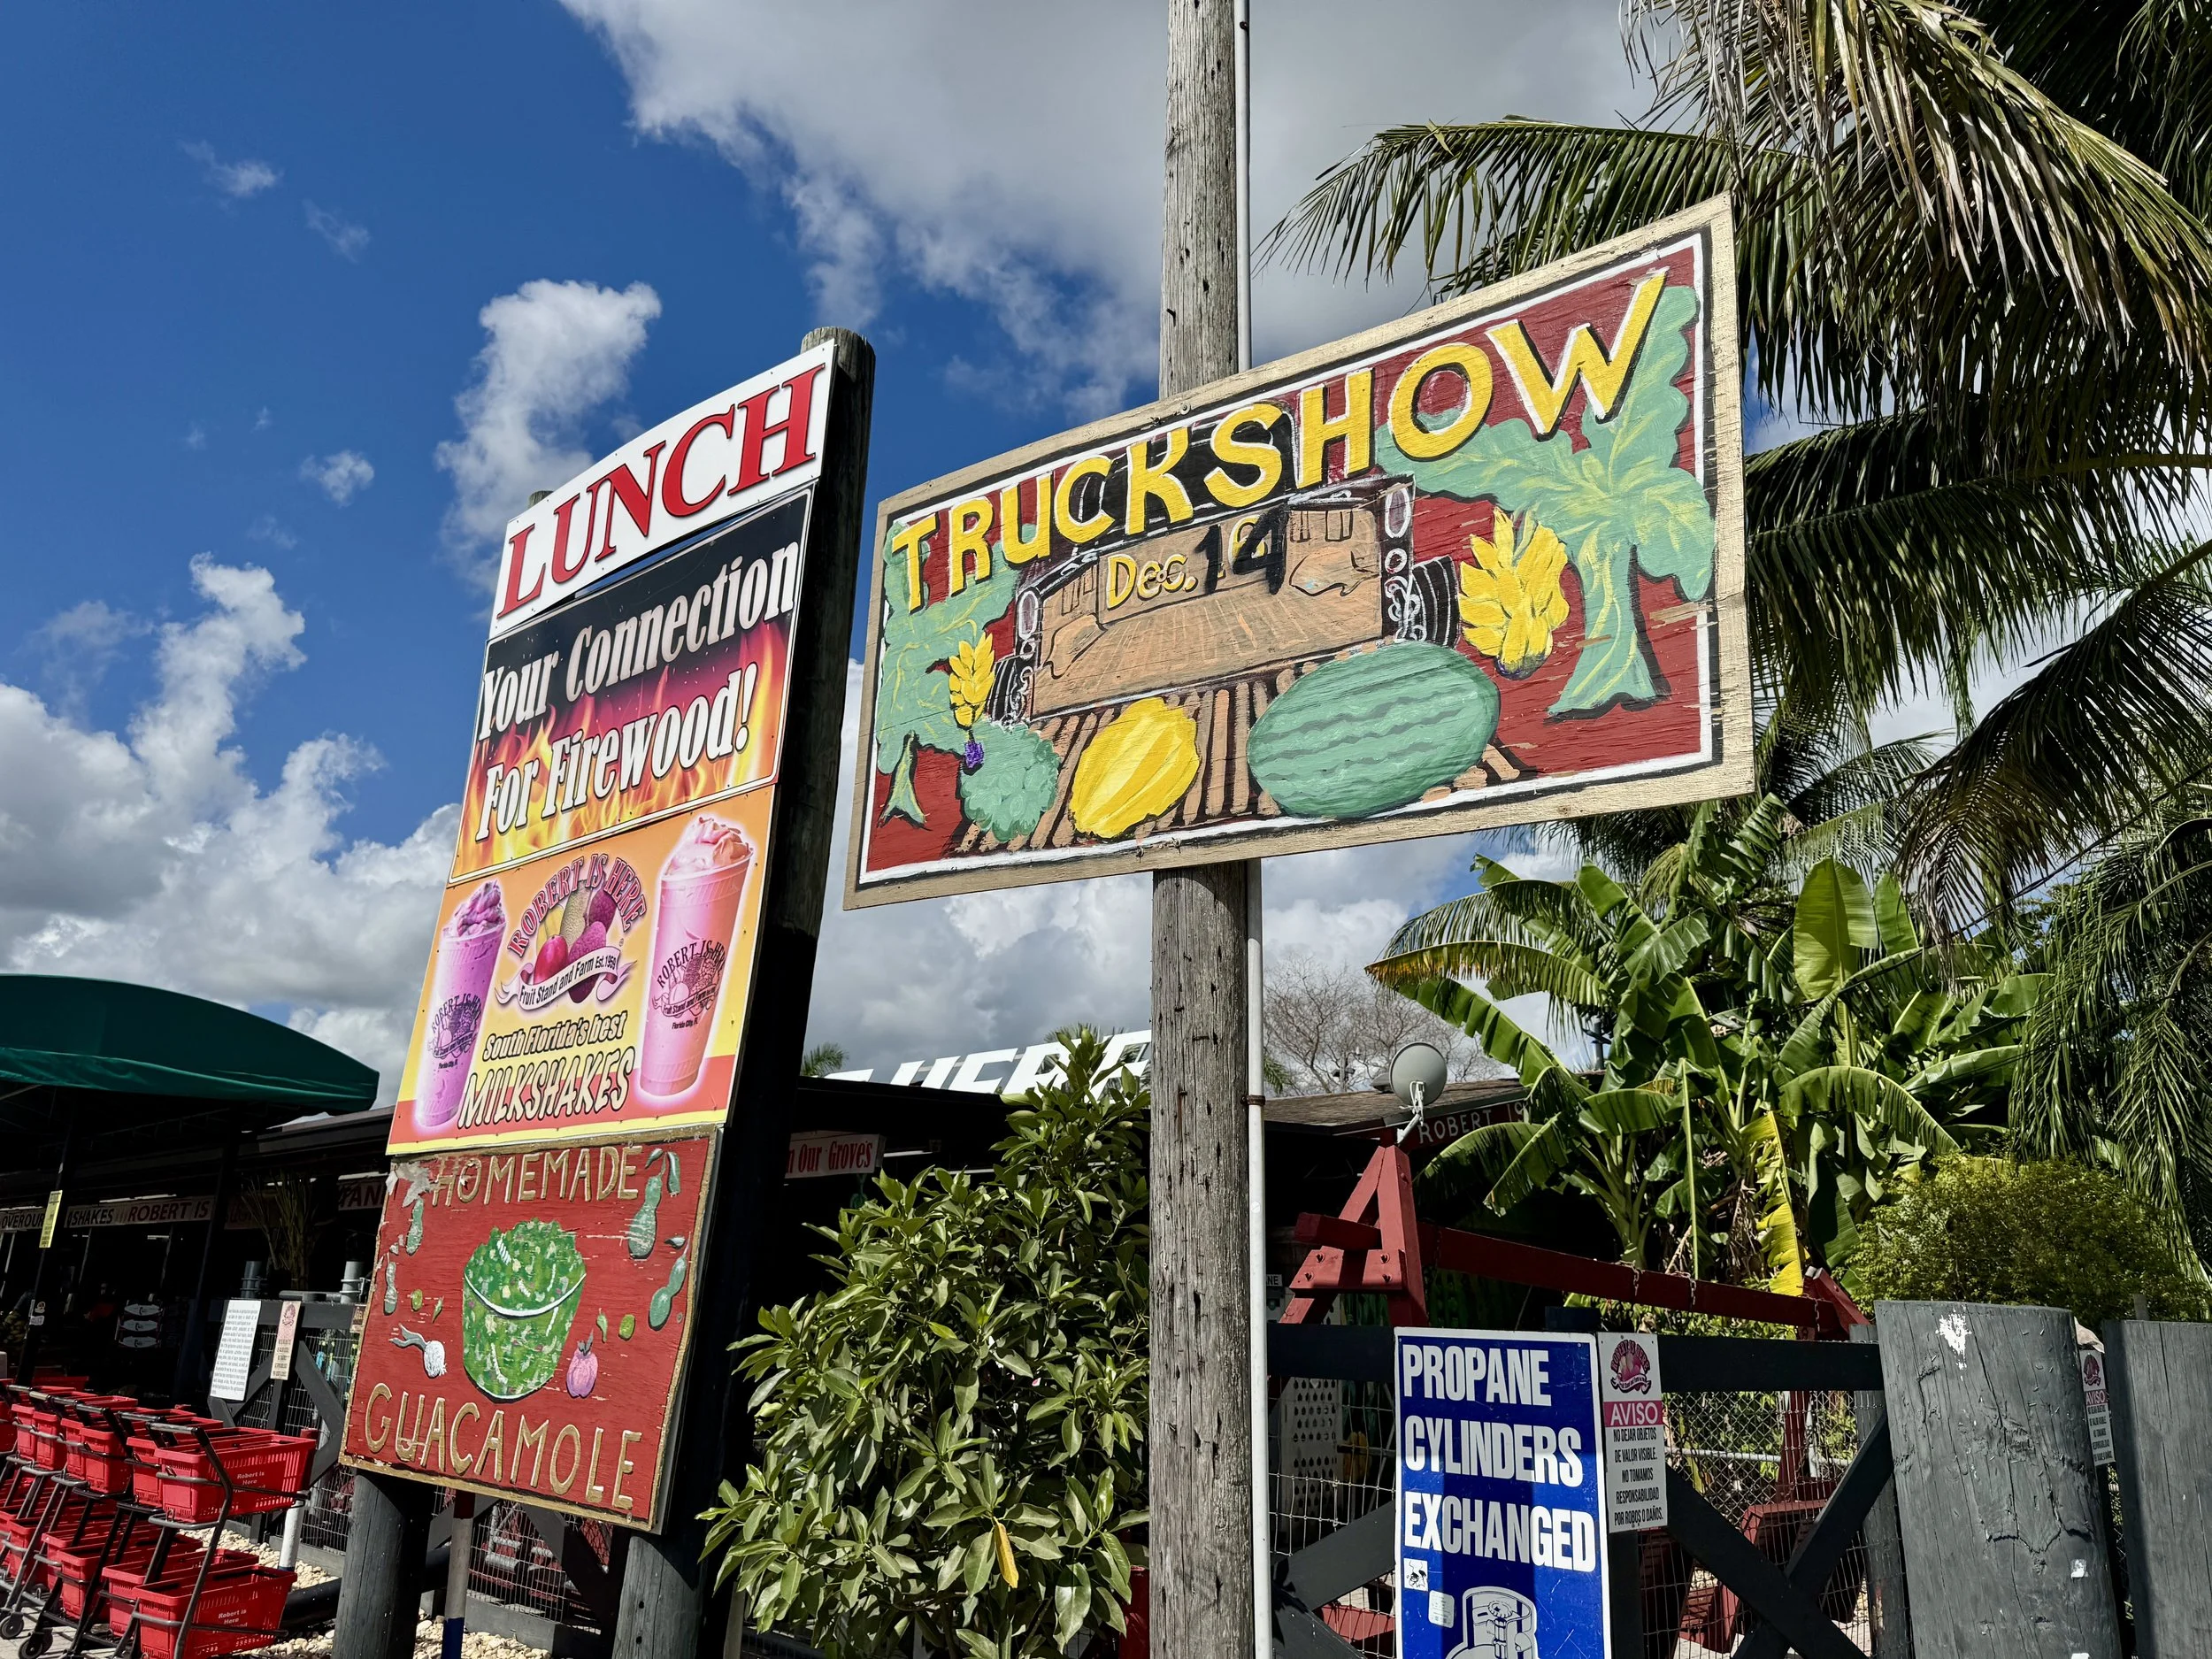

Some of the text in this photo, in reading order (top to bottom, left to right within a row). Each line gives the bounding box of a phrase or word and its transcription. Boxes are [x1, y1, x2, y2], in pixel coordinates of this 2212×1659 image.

[495, 362, 825, 621] LUNCH
[1194, 502, 1291, 595] 14
[478, 540, 799, 741] Your Connection
[475, 661, 758, 842] For Firewood!
[507, 852, 648, 958] ROBERT IS HERE
[519, 955, 617, 1007] Fruit Stand and Farm Est. 1959
[657, 941, 697, 989] ROBERT
[432, 995, 461, 1033] ROBERT
[482, 1028, 526, 1062] South
[525, 1018, 589, 1055] Florida's
[588, 1010, 628, 1045] best
[457, 1045, 636, 1130] MILKSHAKES
[1417, 1109, 1493, 1145] ROBERT
[432, 1145, 642, 1206] HOMEMADE
[799, 1143, 823, 1173] Our
[127, 1202, 193, 1223] ROBERT
[193, 1200, 211, 1219] IS
[1402, 1344, 1553, 1407] PROPANE
[2086, 1390, 2106, 1405] AVISO
[1610, 1402, 1659, 1426] AVISO
[1613, 1427, 1657, 1442] NO DEJAR OBJETOS
[363, 1382, 644, 1509] GUACAMOLE
[1402, 1415, 1585, 1488] CYLINDERS
[1615, 1447, 1658, 1463] DE VALOR VISIBLE.
[1616, 1486, 1659, 1504] RESPONSABILIDAD
[1622, 1467, 1653, 1483] NO TOMAMOS
[1403, 1491, 1596, 1572] EXCHANGED
[1614, 1512, 1624, 1525] POR
[1624, 1509, 1641, 1524] ROBOS
[1641, 1509, 1646, 1522] O
[219, 1609, 240, 1618] Robert
